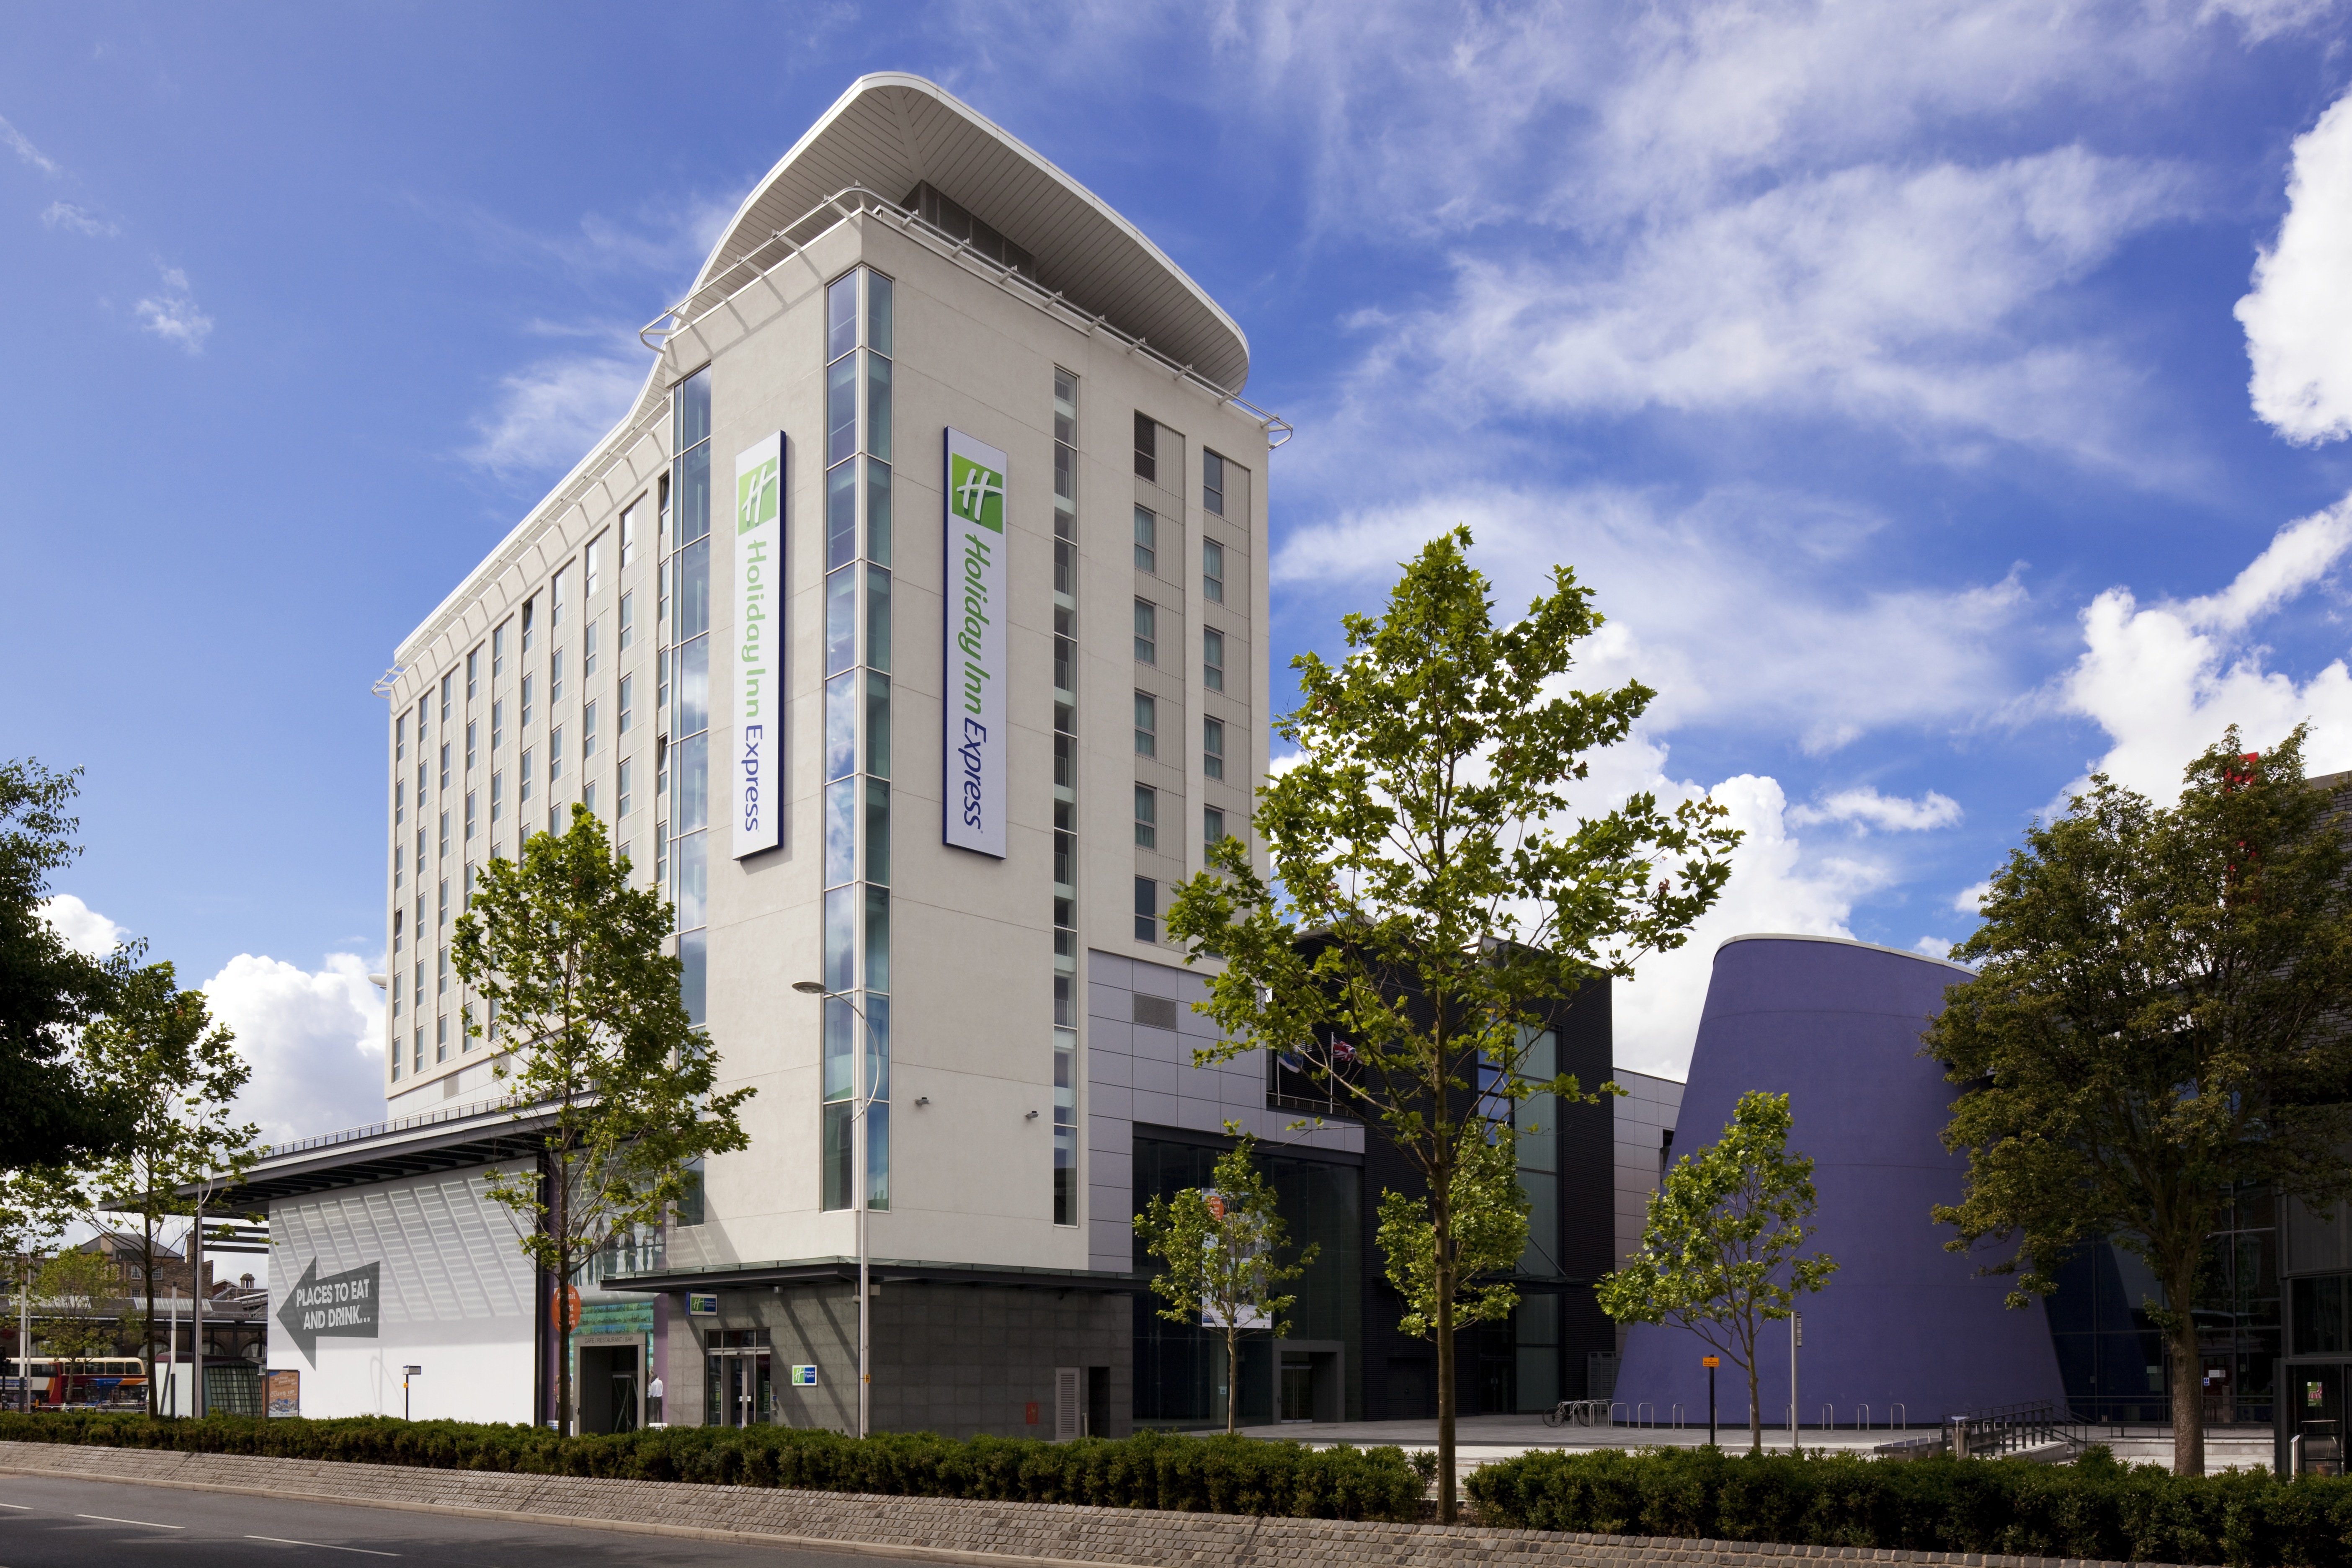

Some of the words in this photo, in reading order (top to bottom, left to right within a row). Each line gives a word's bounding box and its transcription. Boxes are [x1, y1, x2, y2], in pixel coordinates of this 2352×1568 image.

[741, 539, 766, 662] Holiday
[957, 533, 991, 660] Holiday
[746, 668, 766, 717] Inn
[964, 661, 990, 714] Inn
[740, 725, 763, 832] Express
[957, 717, 987, 830] Express
[297, 1284, 333, 1307] PLACES
[335, 1282, 349, 1302] TO
[351, 1279, 369, 1300] EAT
[303, 1310, 325, 1330] AND
[328, 1305, 370, 1328] DRINK...
